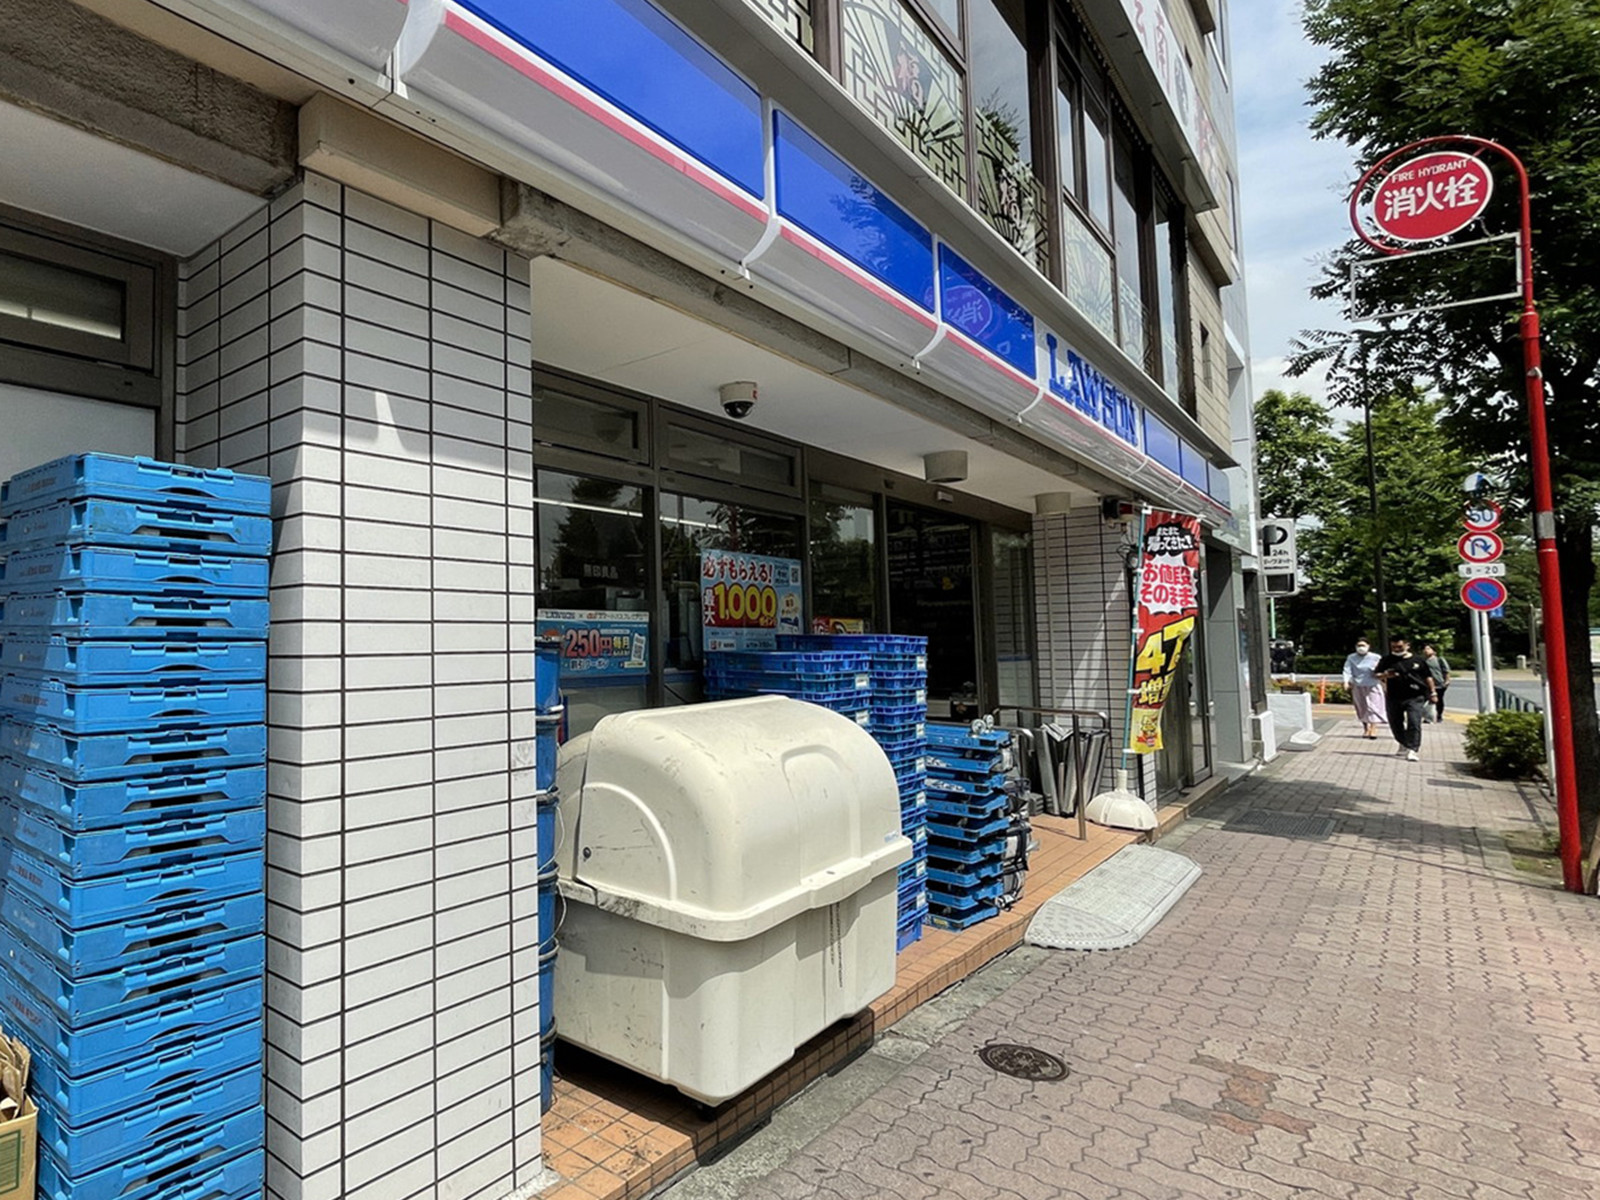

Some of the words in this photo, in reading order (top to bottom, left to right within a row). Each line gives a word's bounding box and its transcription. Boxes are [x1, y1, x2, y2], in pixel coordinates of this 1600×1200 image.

[1391, 169, 1414, 184] FIRE
[1418, 159, 1468, 178] HYDRANT
[1383, 172, 1480, 222] 消火栓
[1046, 333, 1138, 448] LAWSON
[1469, 508, 1494, 522] 50
[703, 556, 774, 584] 必ずもらえる!
[1143, 563, 1192, 585] お値段
[703, 589, 715, 625] 最大
[714, 582, 776, 620] 1,000
[1140, 584, 1195, 607] そのまま
